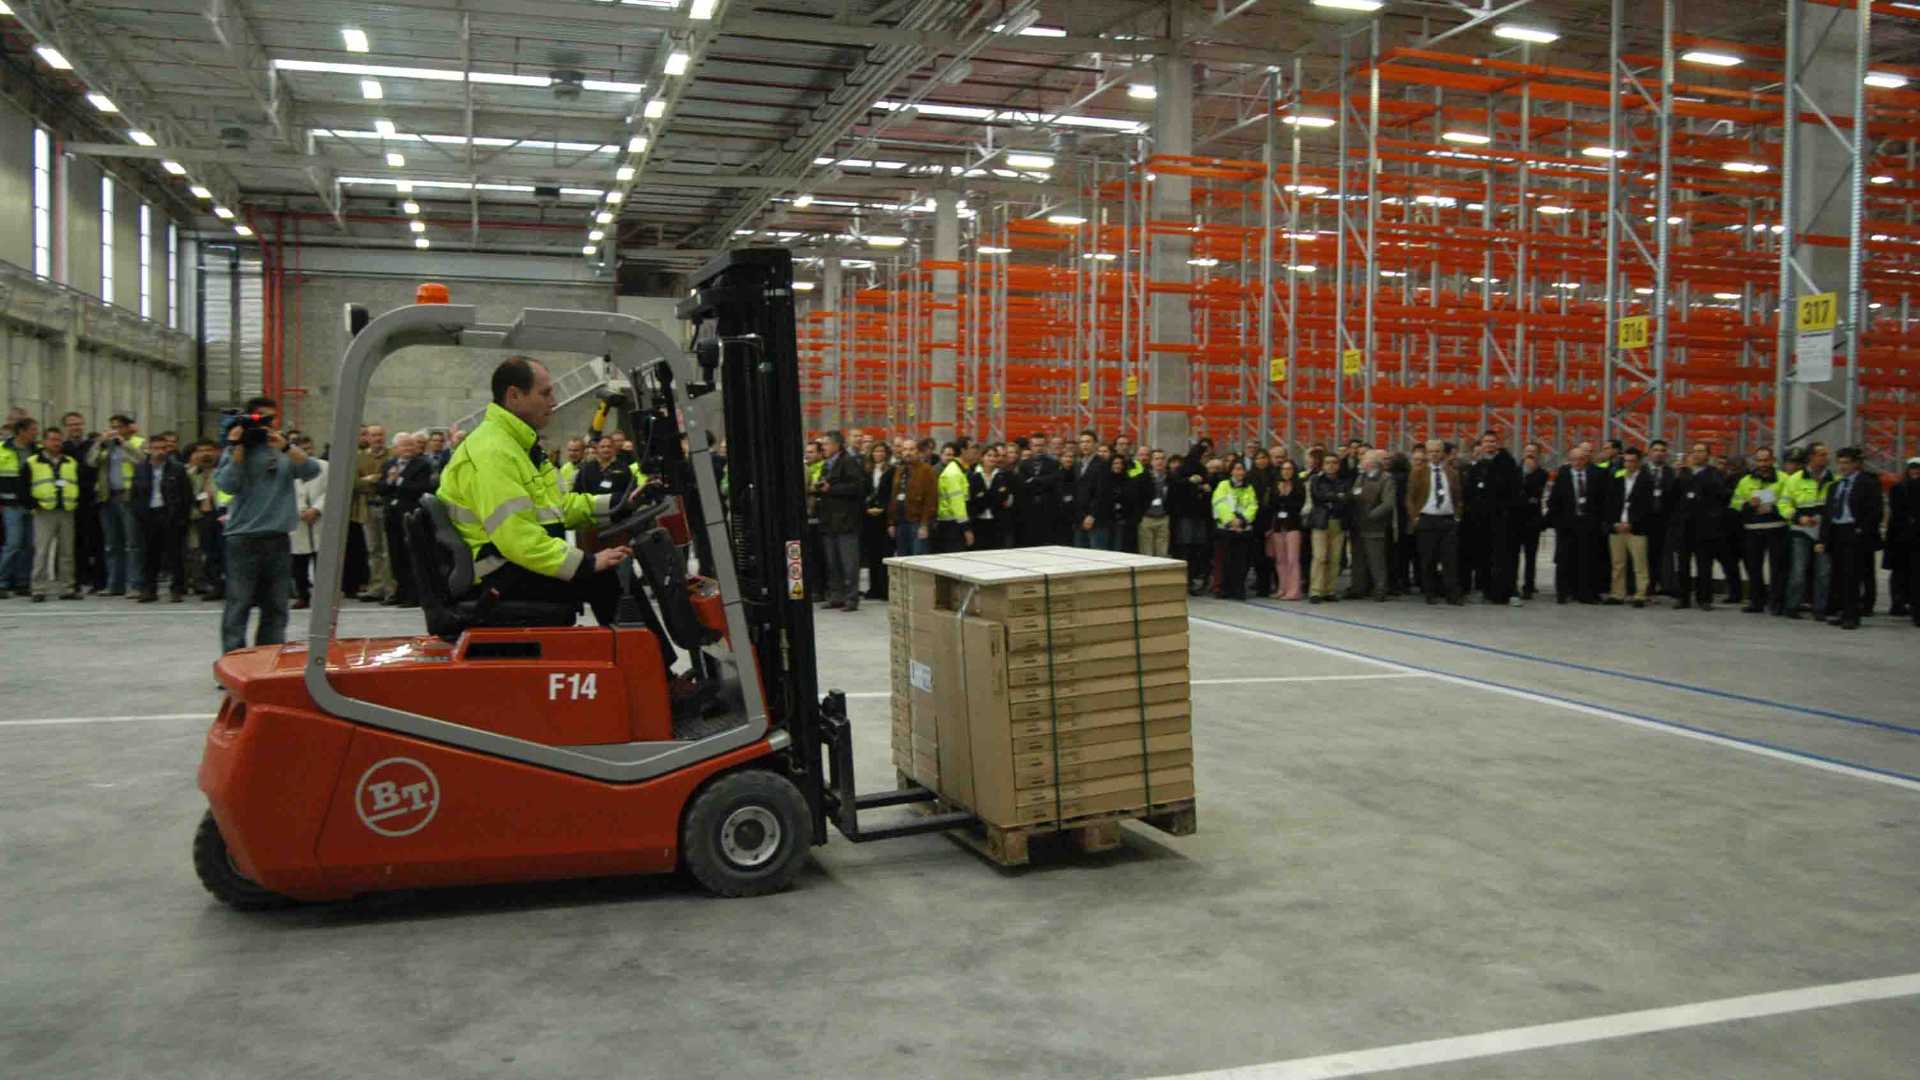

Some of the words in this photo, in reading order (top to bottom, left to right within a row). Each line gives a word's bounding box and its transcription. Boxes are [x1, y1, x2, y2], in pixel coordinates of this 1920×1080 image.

[1802, 300, 1830, 325] 317
[1623, 322, 1643, 343] 316
[549, 673, 597, 700] F14
[368, 781, 429, 811] BT
